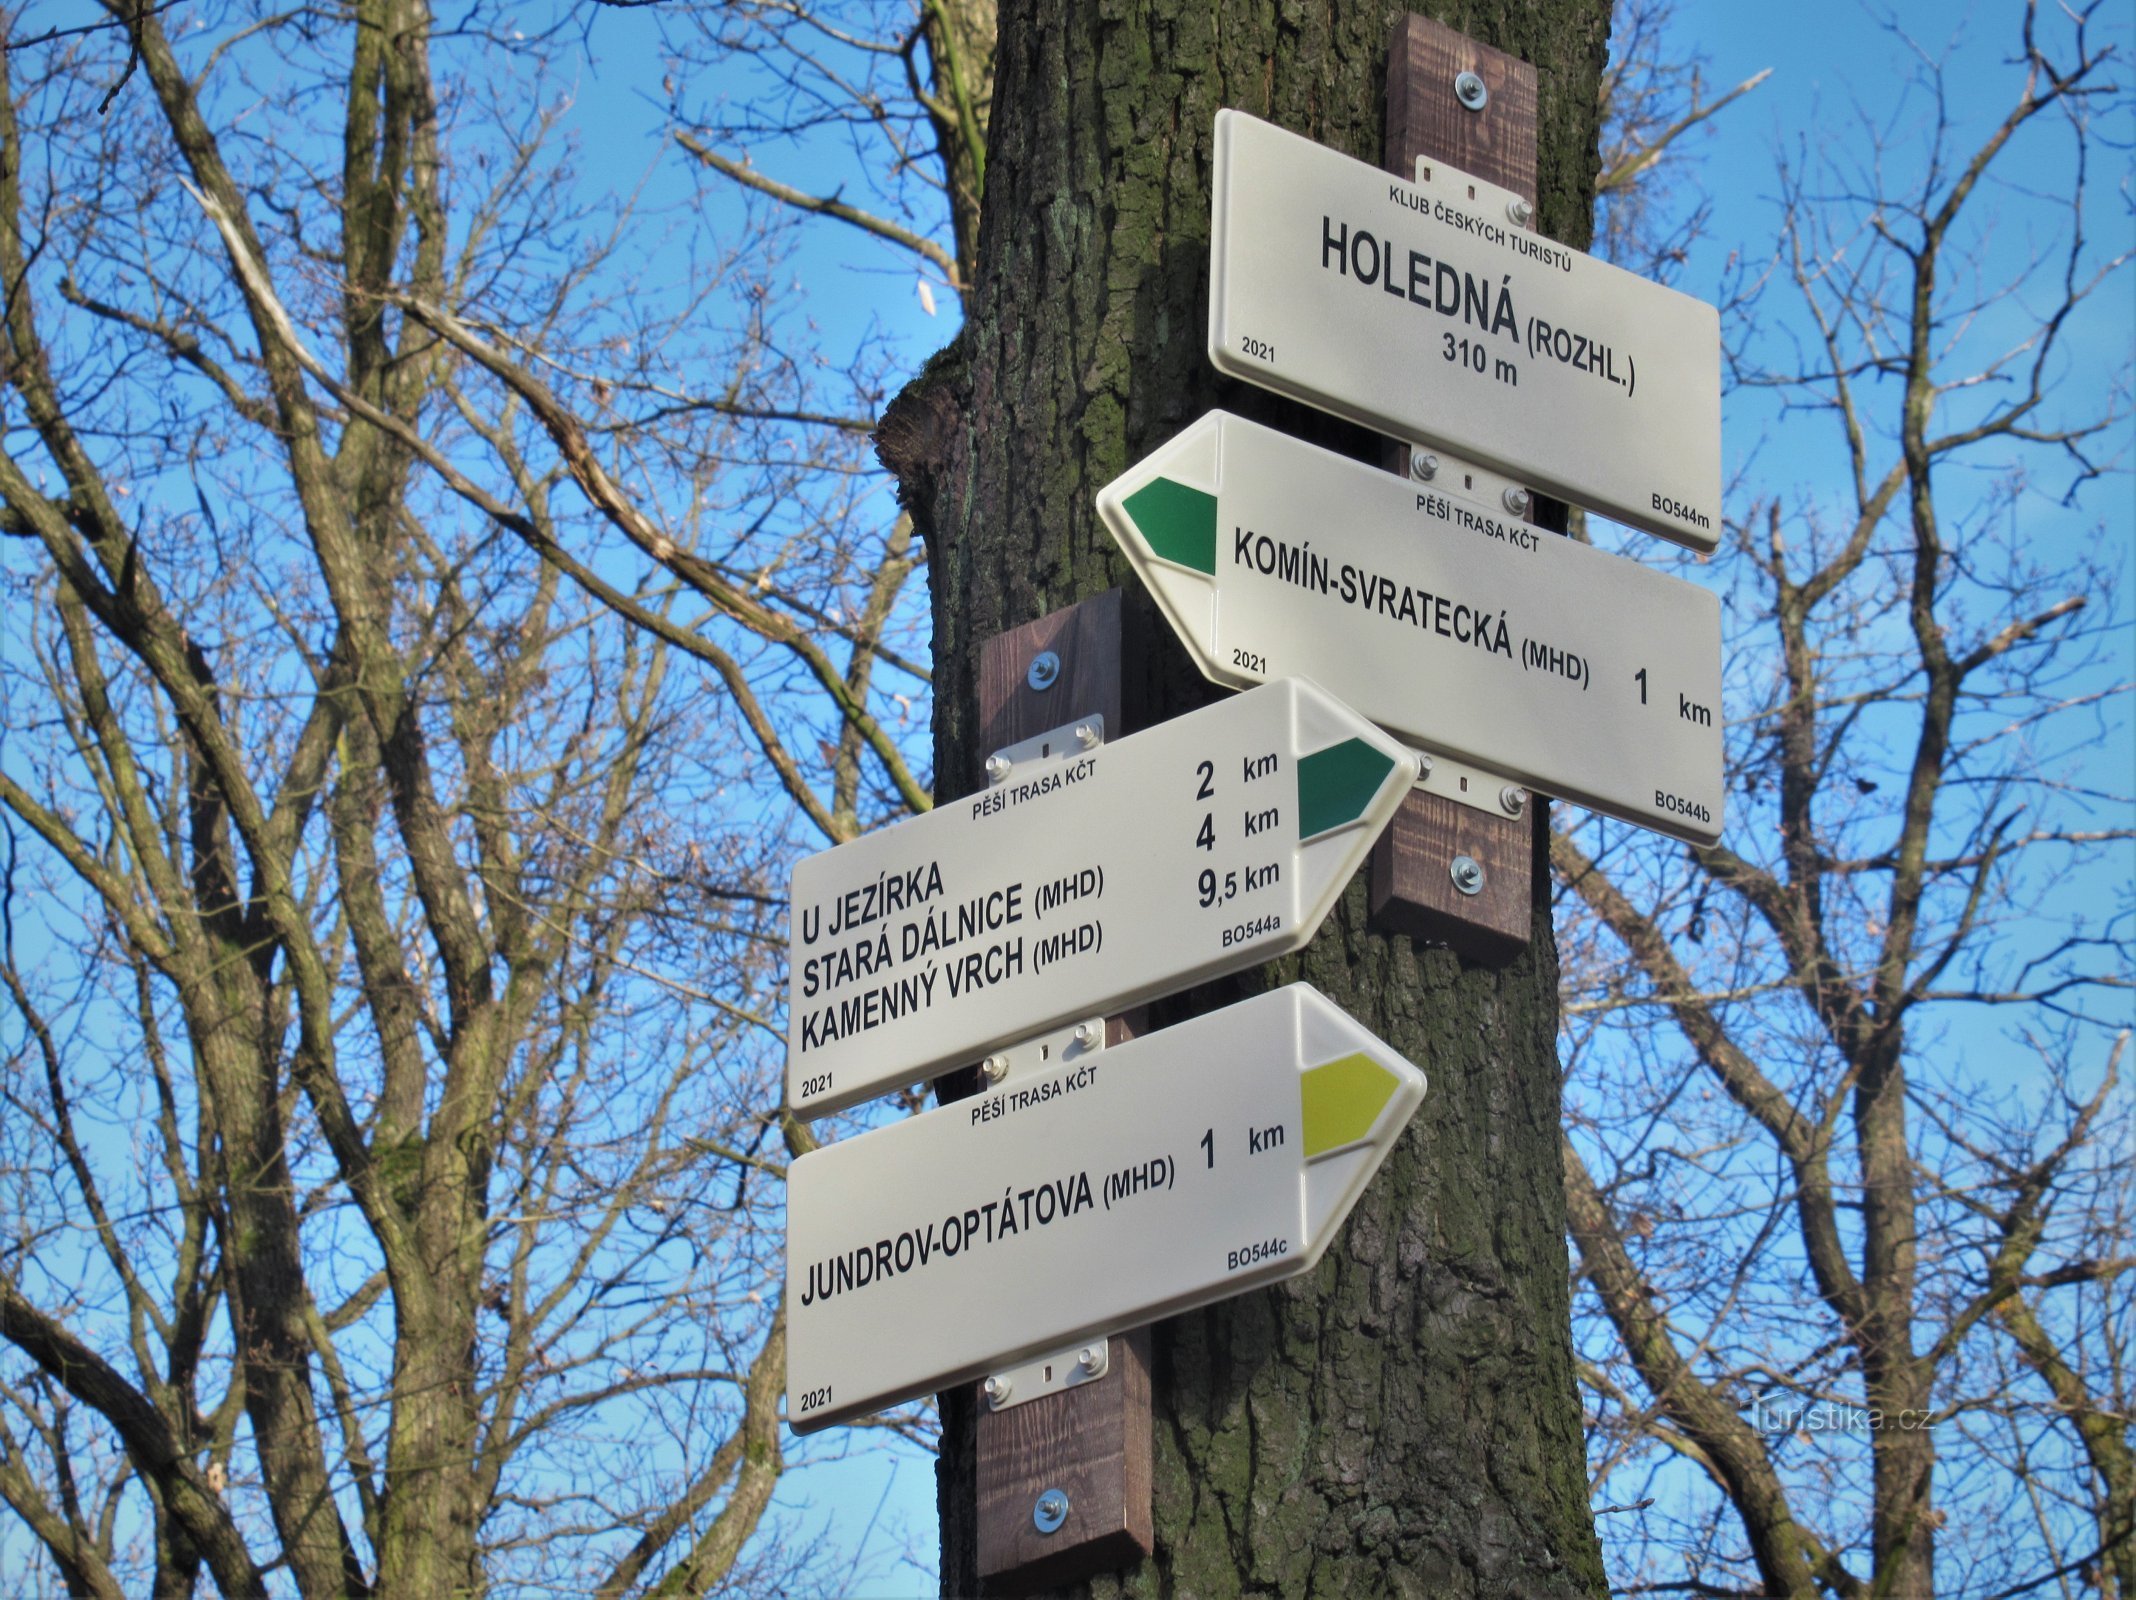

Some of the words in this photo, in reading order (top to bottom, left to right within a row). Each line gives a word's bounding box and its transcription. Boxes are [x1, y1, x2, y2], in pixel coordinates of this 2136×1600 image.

[1390, 185, 1429, 214] KLUB
[1435, 200, 1504, 246] ČESKÝCH
[1510, 234, 1571, 272] TURISTŮ
[1322, 215, 1519, 343] HOLEDNÁ
[1528, 317, 1634, 397] (ROZHL.)
[1242, 337, 1274, 362] 2021
[1443, 333, 1486, 373] 310
[1496, 359, 1516, 386] m
[1417, 494, 1450, 521] PĚŠÍ
[1455, 508, 1505, 541] TRASA
[1510, 528, 1539, 552] KČT
[1652, 493, 1709, 529] BO544m
[1234, 526, 1512, 659] KOMÍN-SVRATECKÁ
[1522, 638, 1589, 691] (MHD)
[1635, 668, 1646, 704] 1
[1680, 693, 1710, 727] km
[1233, 649, 1265, 674] 2021
[973, 789, 1005, 820] PĚŠÍ
[1010, 774, 1061, 805] TRASA
[1066, 759, 1095, 785] KČT
[1656, 790, 1710, 823] BO544b
[803, 905, 819, 944] U
[829, 861, 944, 935] JEZÍRKA
[1197, 761, 1214, 801] 2
[1244, 753, 1277, 782] km
[804, 923, 893, 997] STARÁ
[903, 883, 1022, 962] DÁLNICE
[1035, 865, 1103, 920] (MHD)
[1196, 813, 1215, 851] 4
[1245, 808, 1278, 837] km
[1223, 915, 1280, 947] BO544a
[802, 961, 937, 1052] KAMENNÝ
[946, 937, 1022, 998] VRCH
[1034, 920, 1102, 975] (MHD)
[1198, 869, 1237, 908] 9,5
[1246, 863, 1279, 892] km
[802, 1072, 832, 1098] 2021
[972, 1094, 1005, 1126] PĚŠÍ
[1010, 1080, 1061, 1111] TRASA
[1066, 1066, 1096, 1093] KČT
[802, 1172, 1093, 1306] JUNDROV-OPTÁTOVA
[1104, 1155, 1174, 1210] (MHD)
[1201, 1128, 1213, 1169] 1
[1250, 1125, 1284, 1155] km
[1228, 1238, 1287, 1270] BO544c
[801, 1385, 831, 1412] 2021
